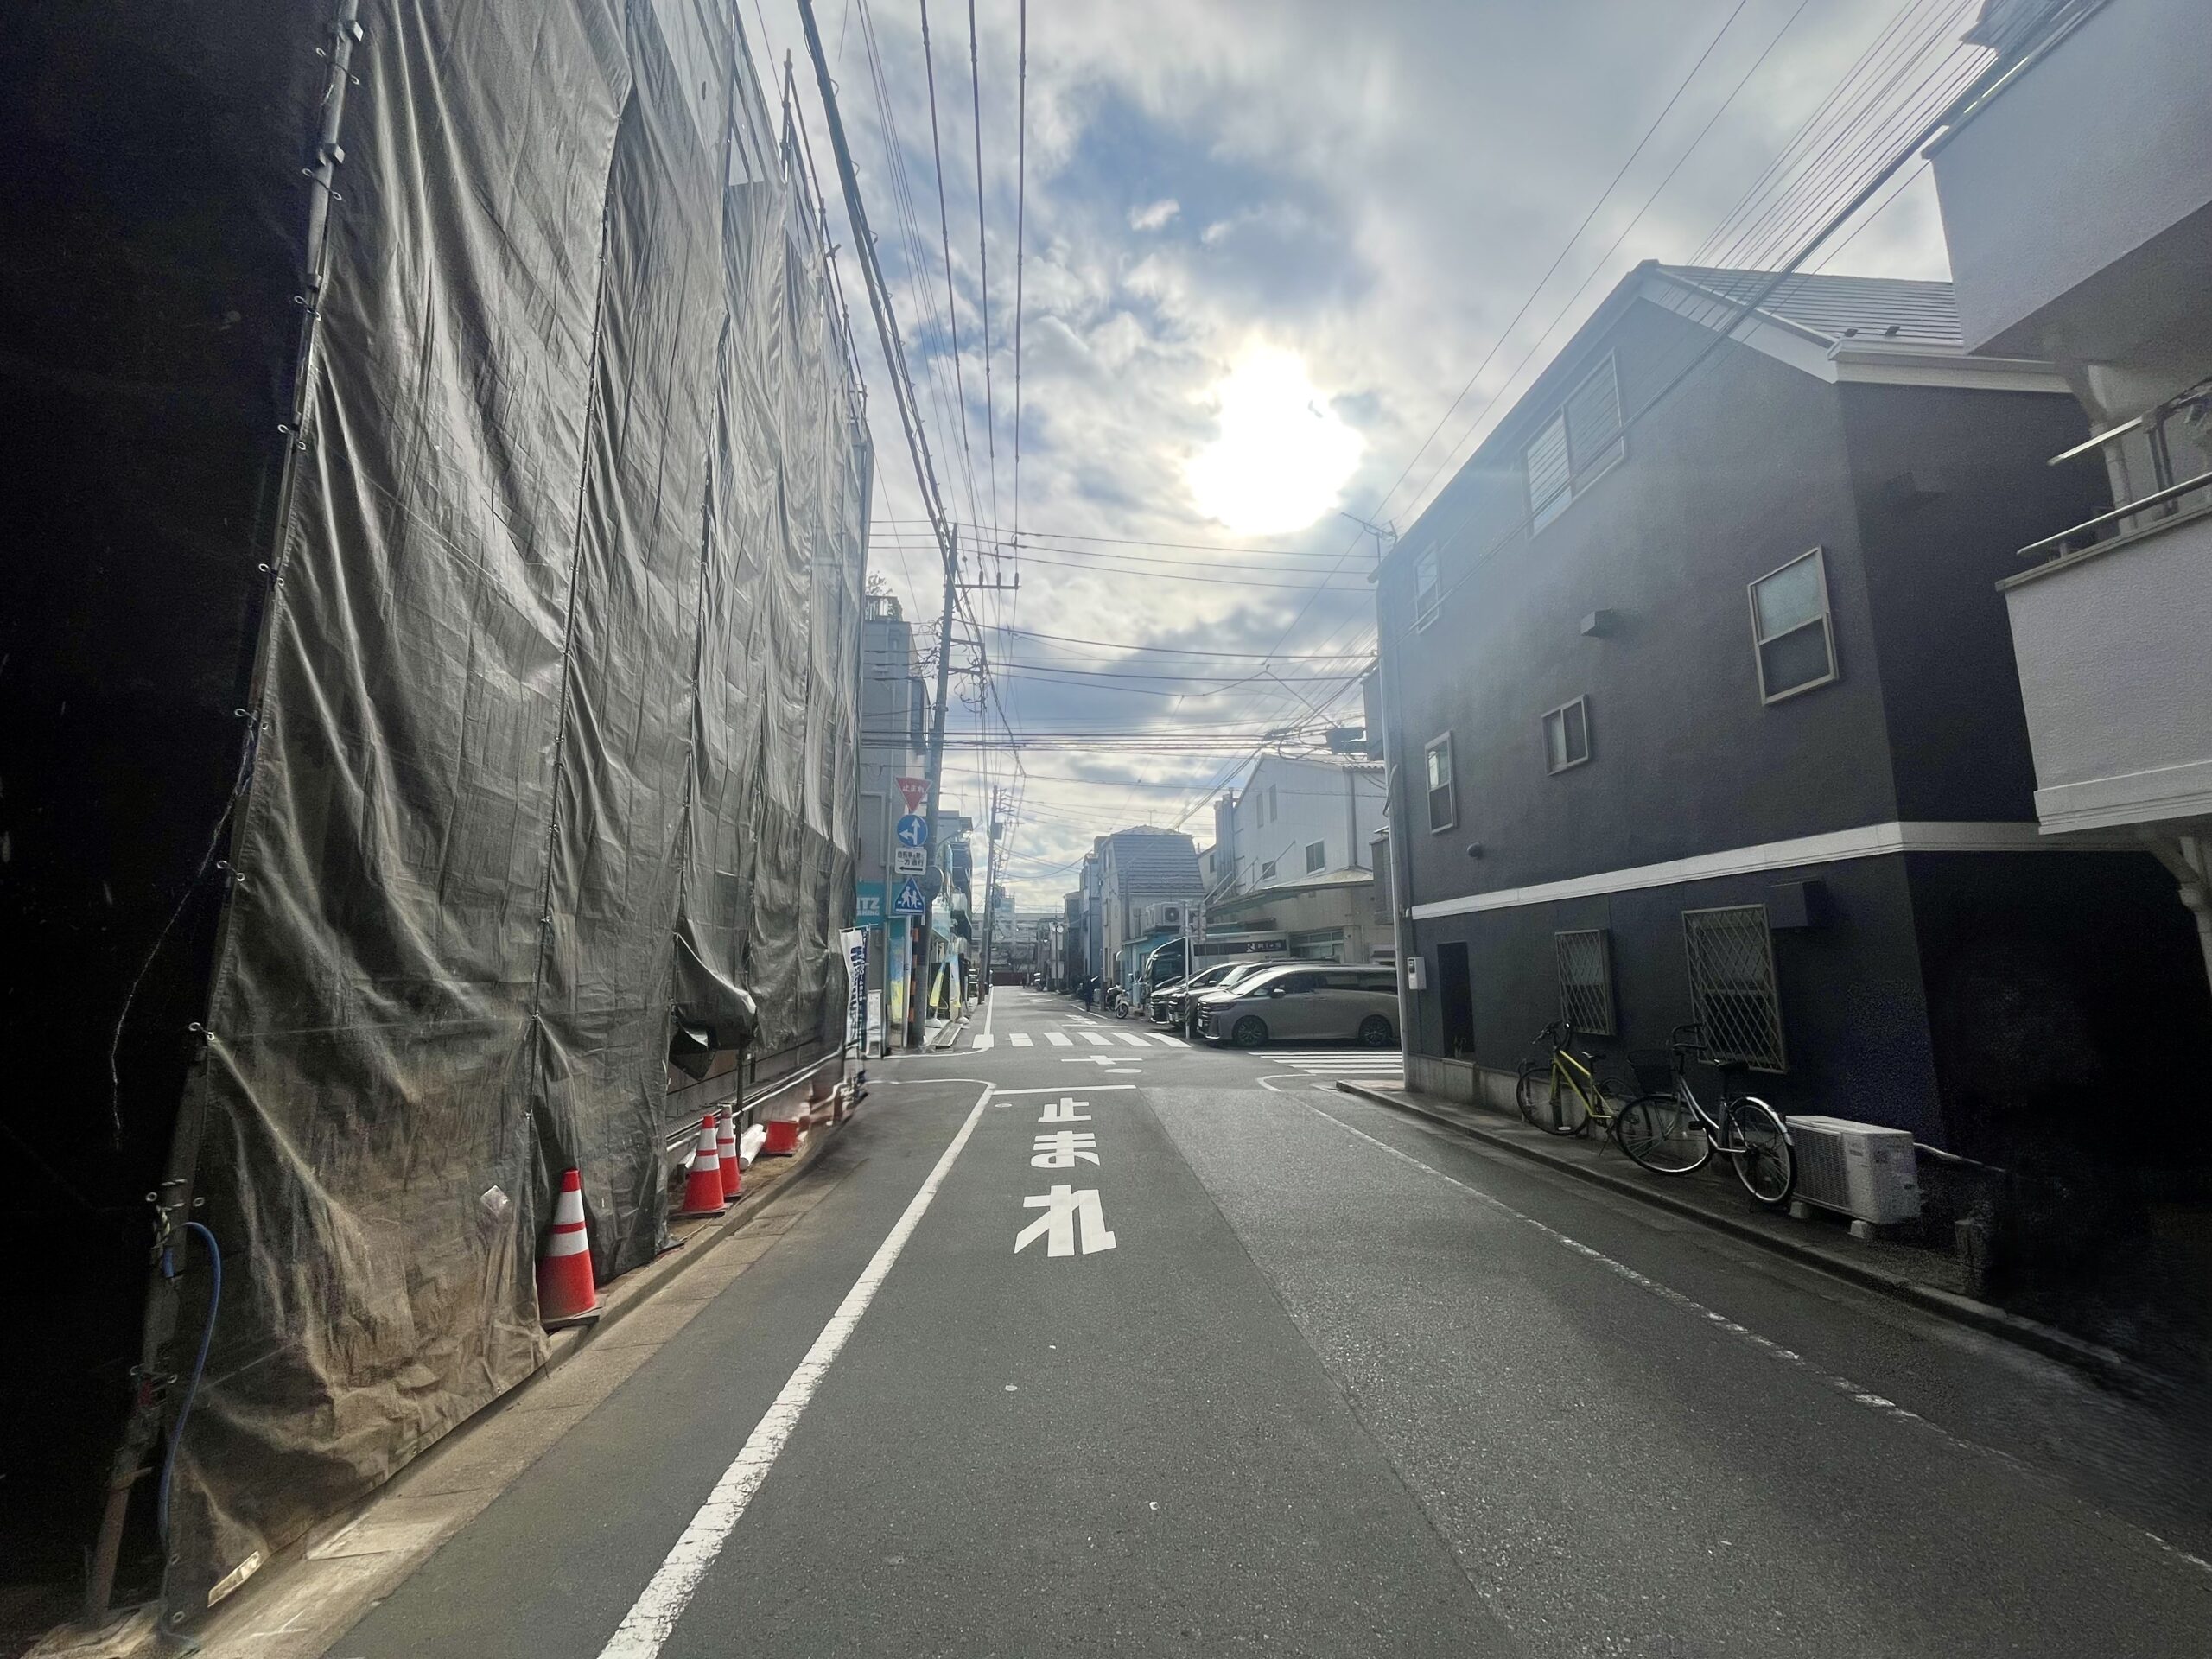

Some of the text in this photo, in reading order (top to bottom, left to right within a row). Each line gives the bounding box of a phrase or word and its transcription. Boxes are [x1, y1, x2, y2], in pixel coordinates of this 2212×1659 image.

[902, 783, 925, 793] 止まれ
[1014, 1097, 1116, 1257] 止まれ
